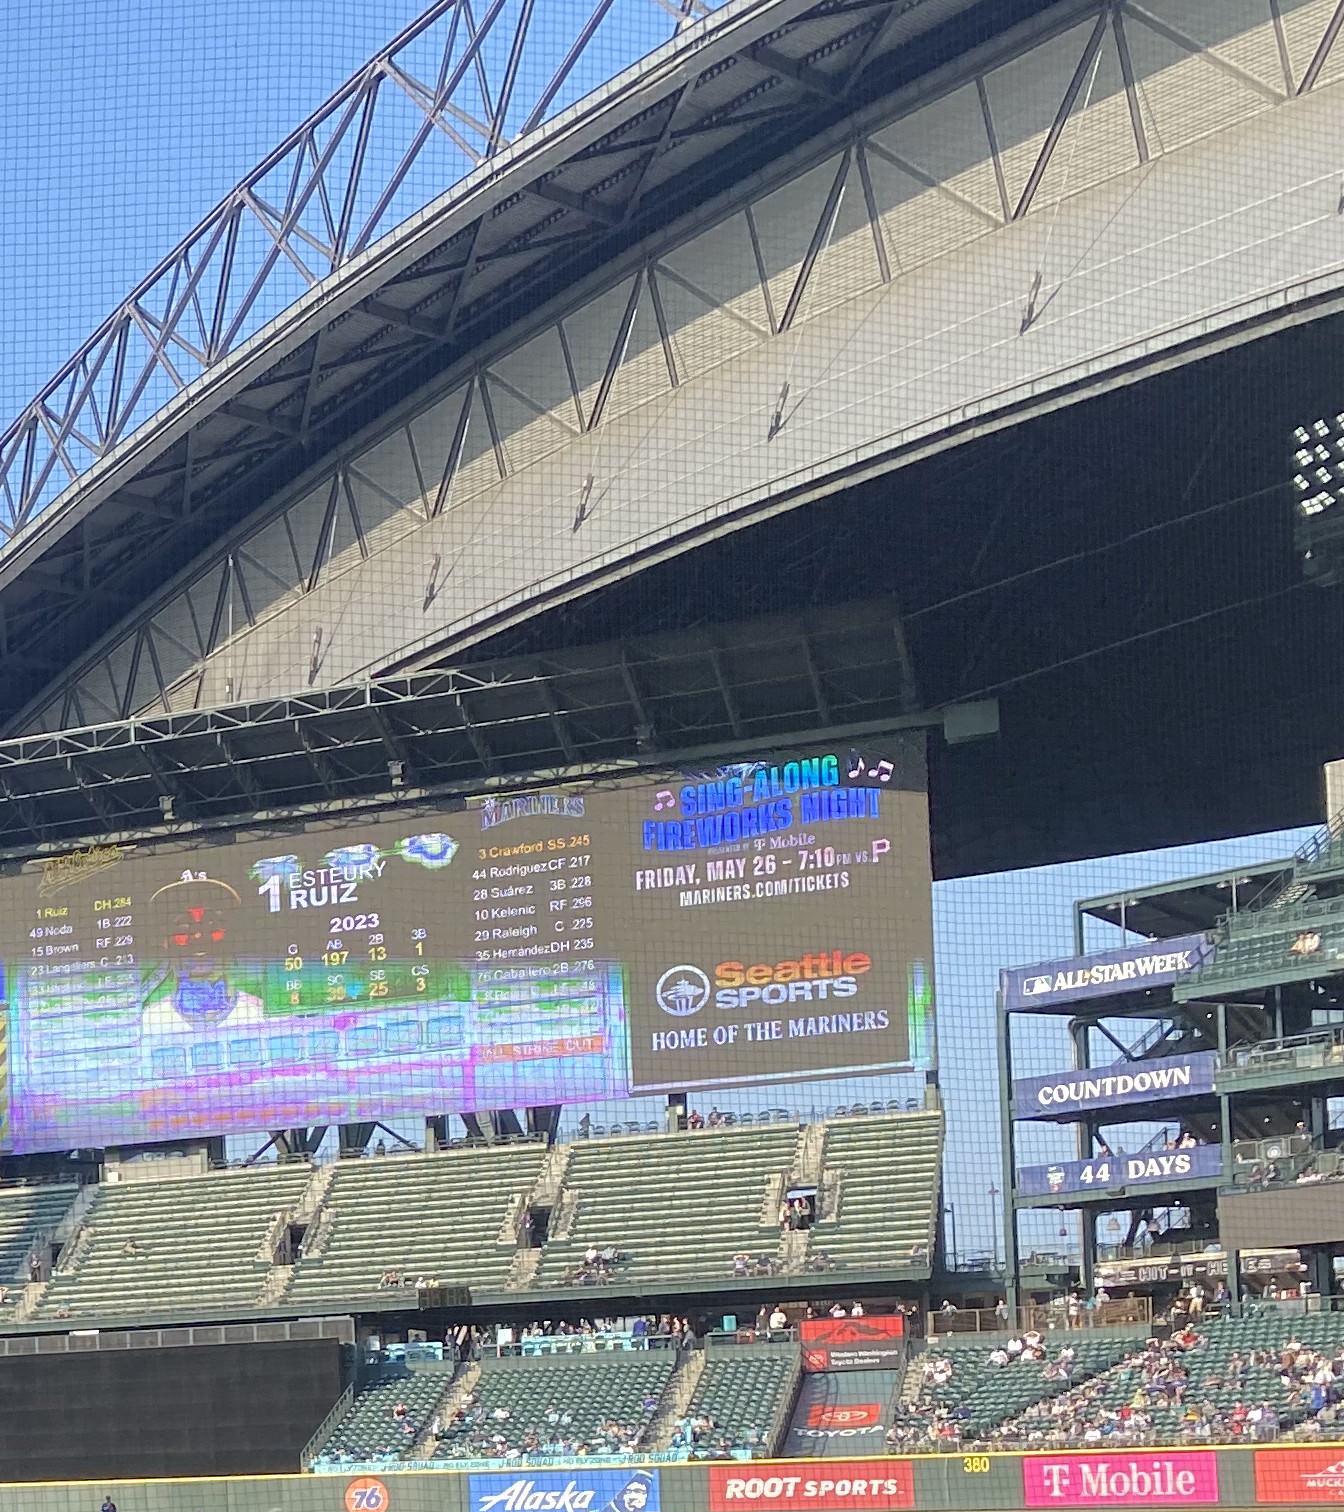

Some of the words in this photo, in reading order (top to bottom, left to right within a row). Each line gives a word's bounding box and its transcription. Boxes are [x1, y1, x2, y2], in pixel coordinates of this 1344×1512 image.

[679, 754, 839, 817] SING-ALONG
[481, 795, 585, 831] MARINERS
[643, 798, 793, 850] FIREWORKS
[800, 787, 881, 825] NIGHT
[479, 848, 486, 859] 3
[489, 841, 543, 858] Crawford
[547, 838, 565, 850] SS
[472, 870, 486, 880] 44
[548, 859, 566, 871] CF
[636, 865, 701, 891] FRIDAY,
[707, 858, 746, 882] MAY
[753, 854, 776, 876] 26
[258, 875, 281, 913] 1
[289, 861, 387, 889] ESTEURY
[290, 882, 358, 910] RUIZ
[473, 889, 487, 901] 28
[549, 879, 566, 891] 3B
[680, 871, 850, 907] MARINERS.COM/TICKETS
[44, 906, 69, 918] Ruiz
[475, 909, 489, 921] 10
[491, 905, 536, 918] Kelenic
[549, 899, 567, 912] RF
[29, 927, 44, 938] 49
[45, 924, 73, 936] Noda
[97, 918, 111, 929] 1B
[330, 912, 380, 933] 2023
[492, 925, 538, 940] Raleigh
[555, 921, 565, 932] C
[31, 947, 44, 957] 15
[46, 943, 79, 956] Brown
[96, 938, 112, 949] RF
[326, 939, 343, 950] AB
[368, 933, 384, 945] 2B
[411, 928, 428, 940] 3B
[284, 956, 304, 971] 50
[321, 951, 349, 966] 197
[368, 947, 387, 961] 13
[415, 942, 424, 956] 1
[476, 951, 490, 961] 35
[550, 940, 570, 953] DH
[31, 965, 45, 976] 23
[411, 965, 430, 976] CS
[715, 949, 872, 988] Seattle
[1137, 950, 1192, 977] WEEK
[368, 982, 389, 997] 25
[416, 977, 426, 992] 3
[716, 976, 858, 1010] SPORTS
[652, 1028, 708, 1051] HOME
[713, 1024, 739, 1045] OF
[744, 1020, 784, 1042] THE
[789, 1010, 889, 1039] MARINERS
[1038, 1066, 1191, 1105] COUNTDOWN
[1080, 1162, 1111, 1184] 44
[1128, 1154, 1191, 1180] DAYS
[793, 1425, 884, 1438] TOYOTA
[963, 1456, 990, 1473] 380
[726, 1476, 801, 1499] ROOT
[1078, 1461, 1196, 1497] Mobile
[350, 1488, 382, 1510] 76
[480, 1480, 597, 1512] Alaska
